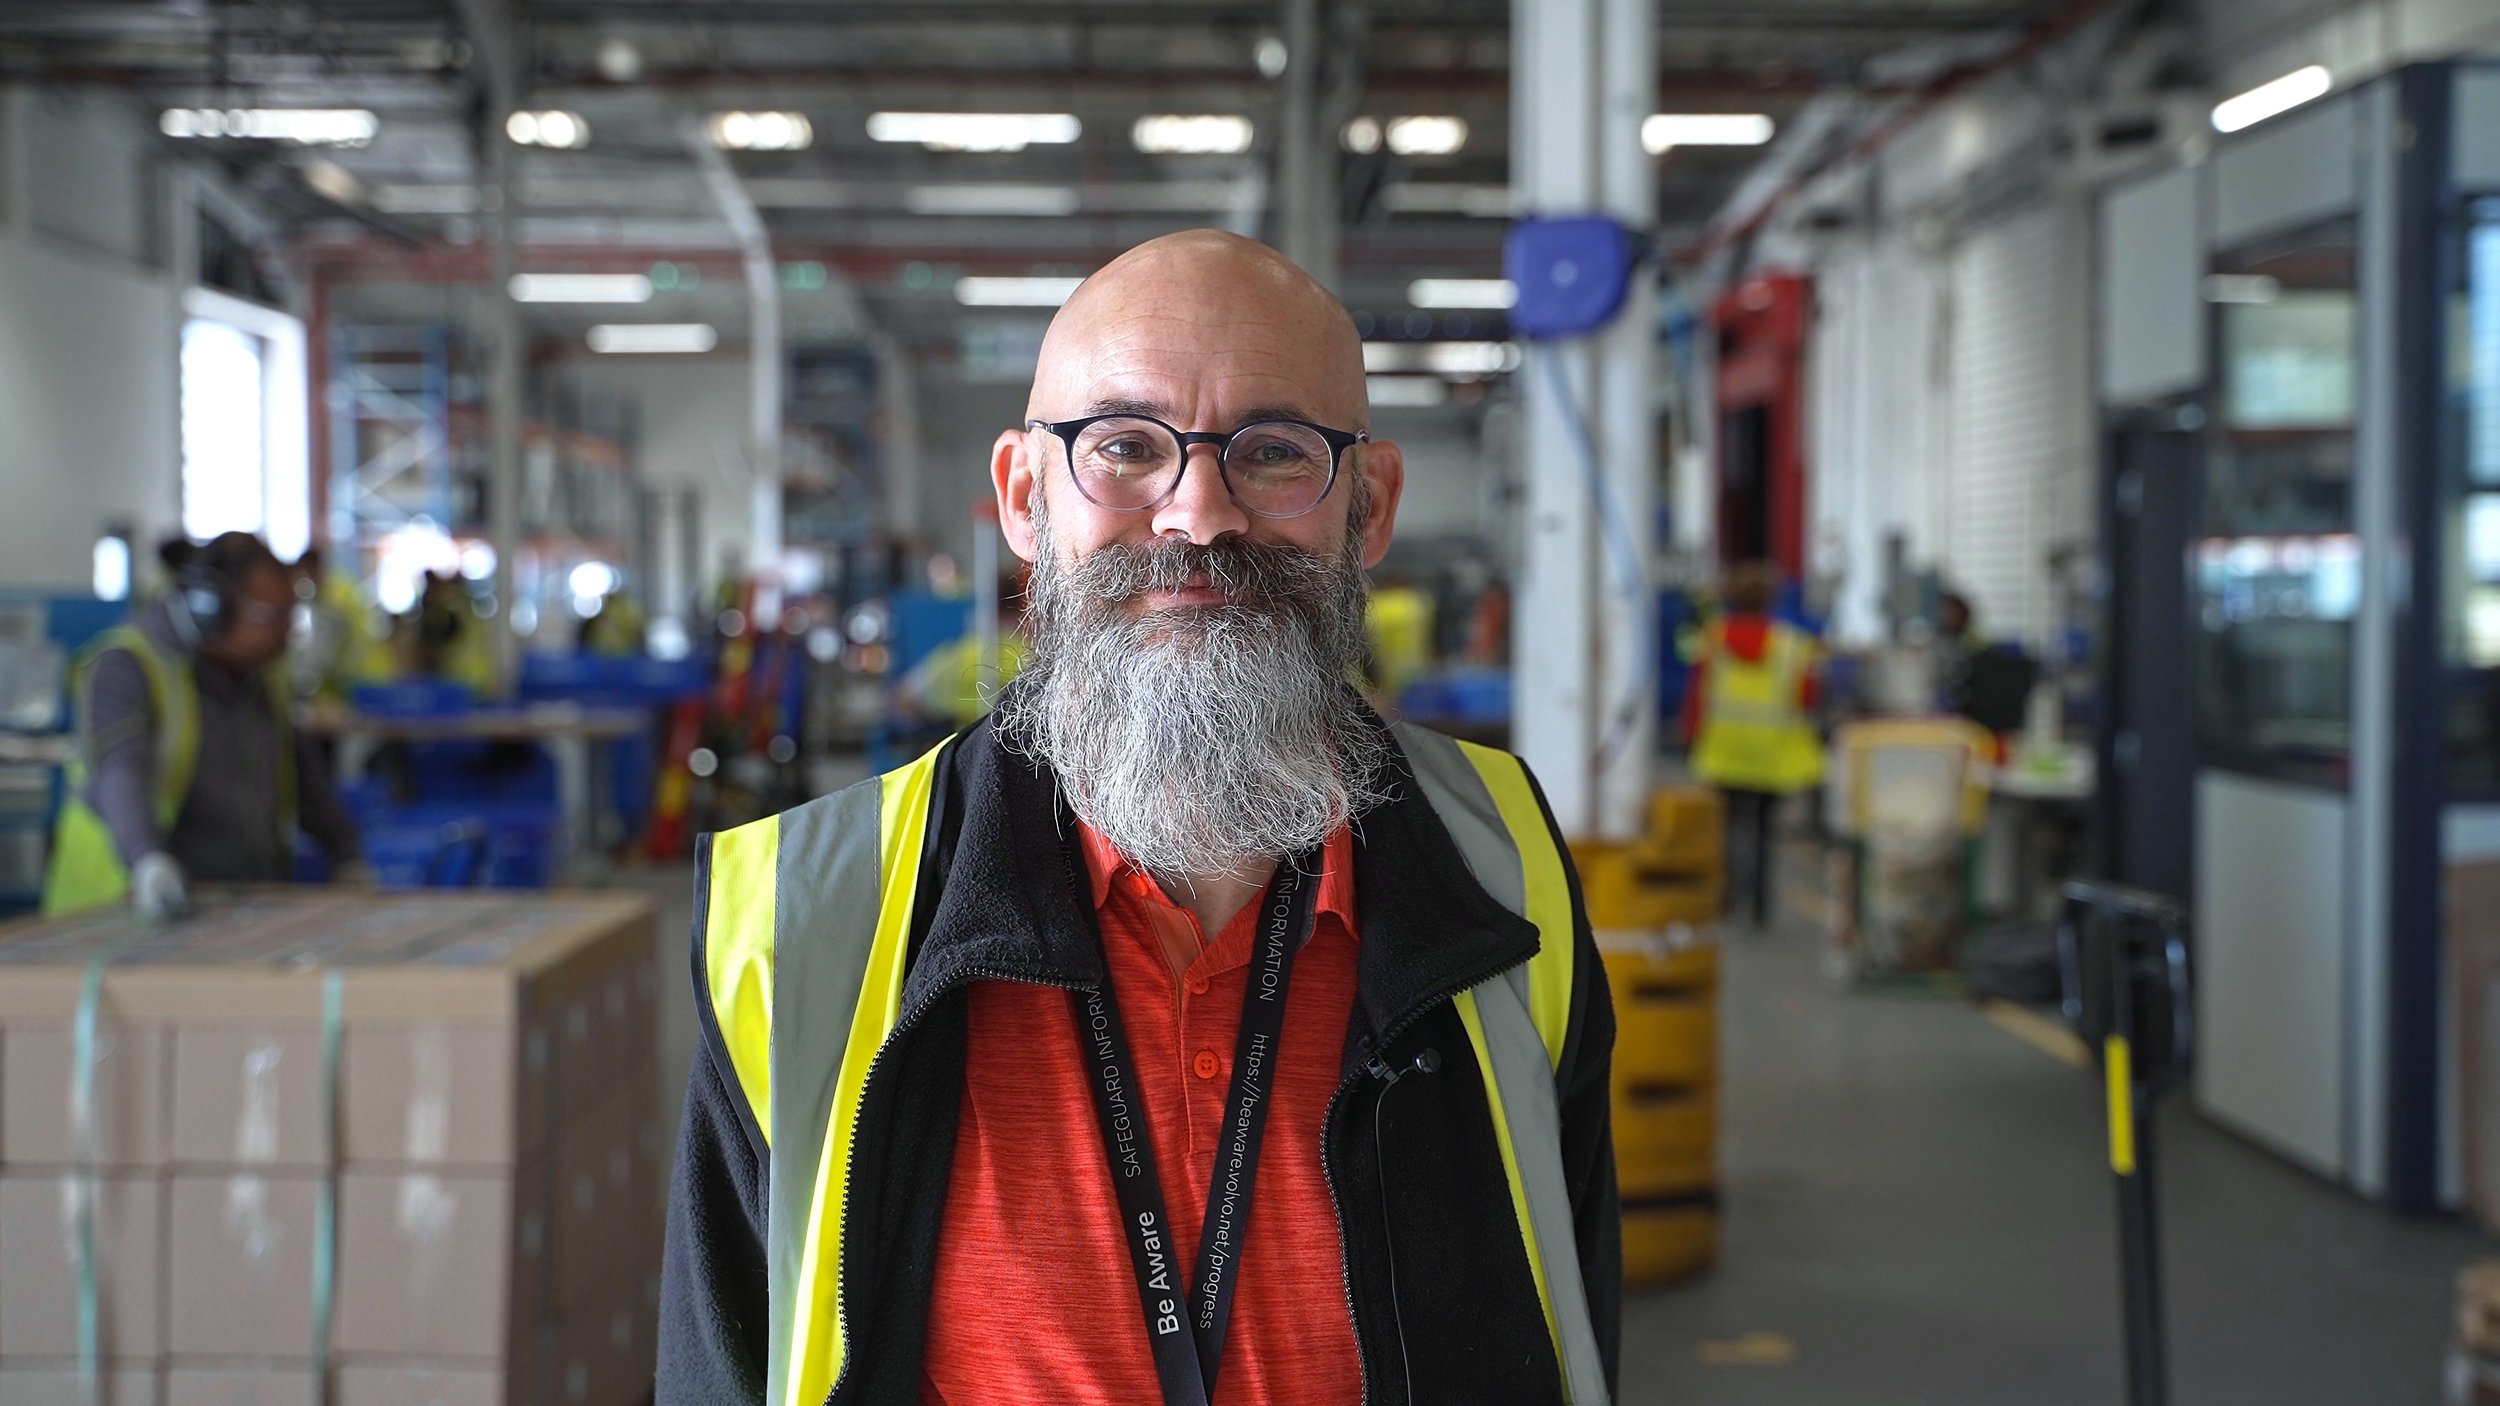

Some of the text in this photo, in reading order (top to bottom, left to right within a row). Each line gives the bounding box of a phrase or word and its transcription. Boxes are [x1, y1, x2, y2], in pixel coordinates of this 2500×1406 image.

[1259, 878, 1294, 1001] INFORMATION
[1103, 1064, 1141, 1178] SAFEGUARD
[1199, 1033, 1270, 1329] https://beaware.volvo.net/progress
[1138, 1211, 1180, 1335] Be Aware
